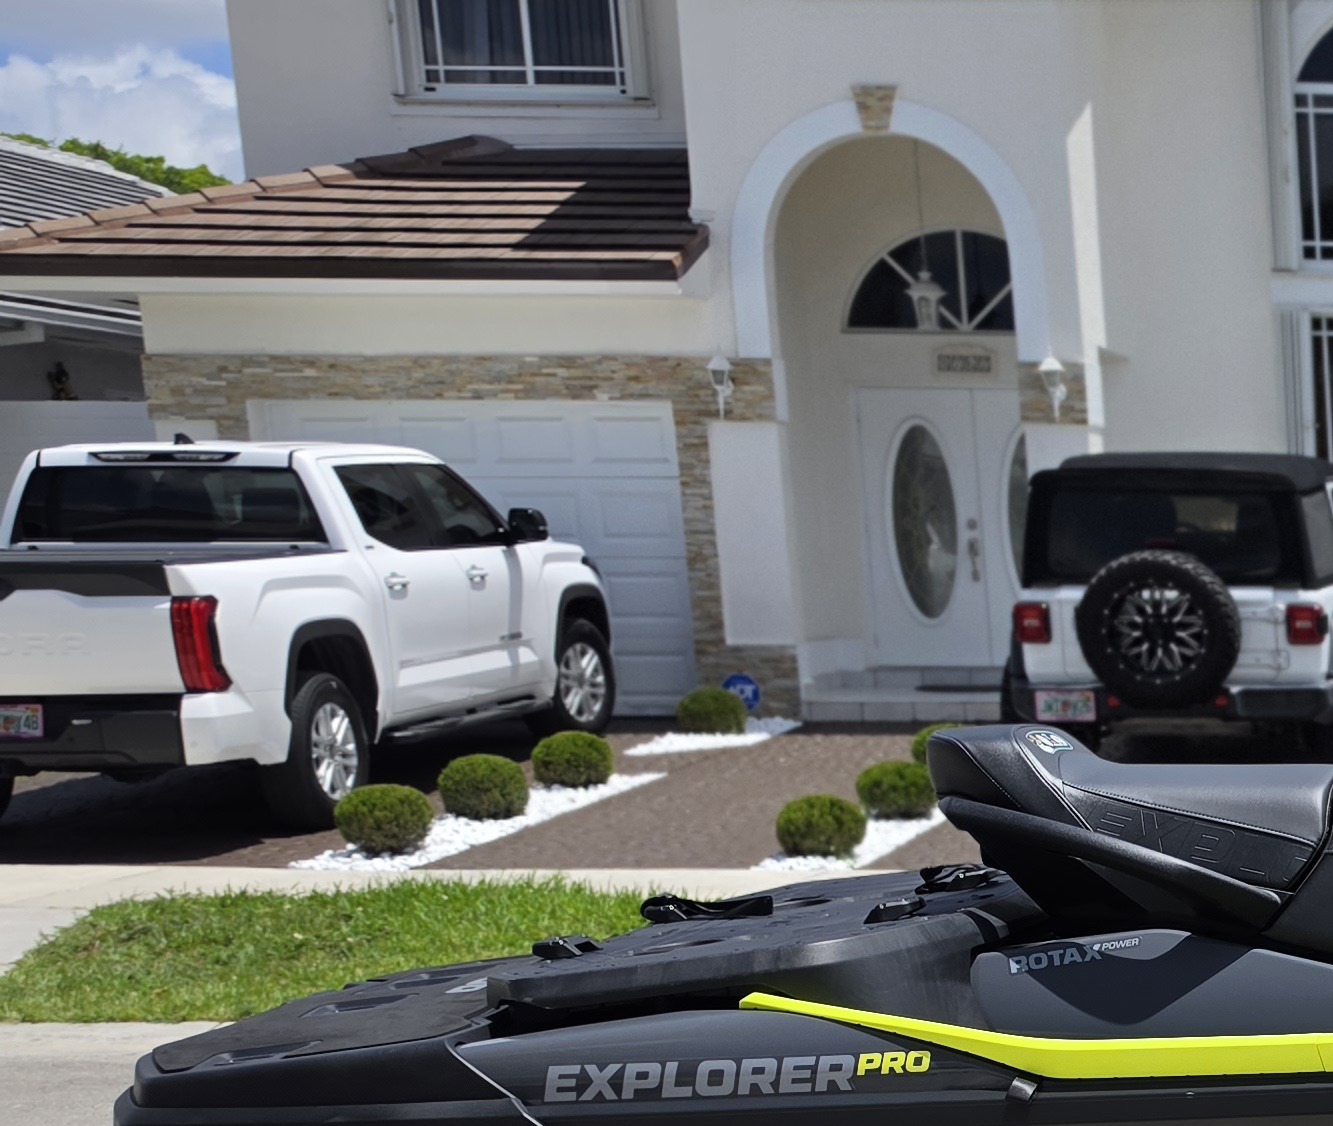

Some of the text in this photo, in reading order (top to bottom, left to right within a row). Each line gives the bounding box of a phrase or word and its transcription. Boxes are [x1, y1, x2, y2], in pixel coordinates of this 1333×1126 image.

[1009, 937, 1139, 974] ROTAX POWER
[543, 1050, 931, 1102] EXPLORER PRO
